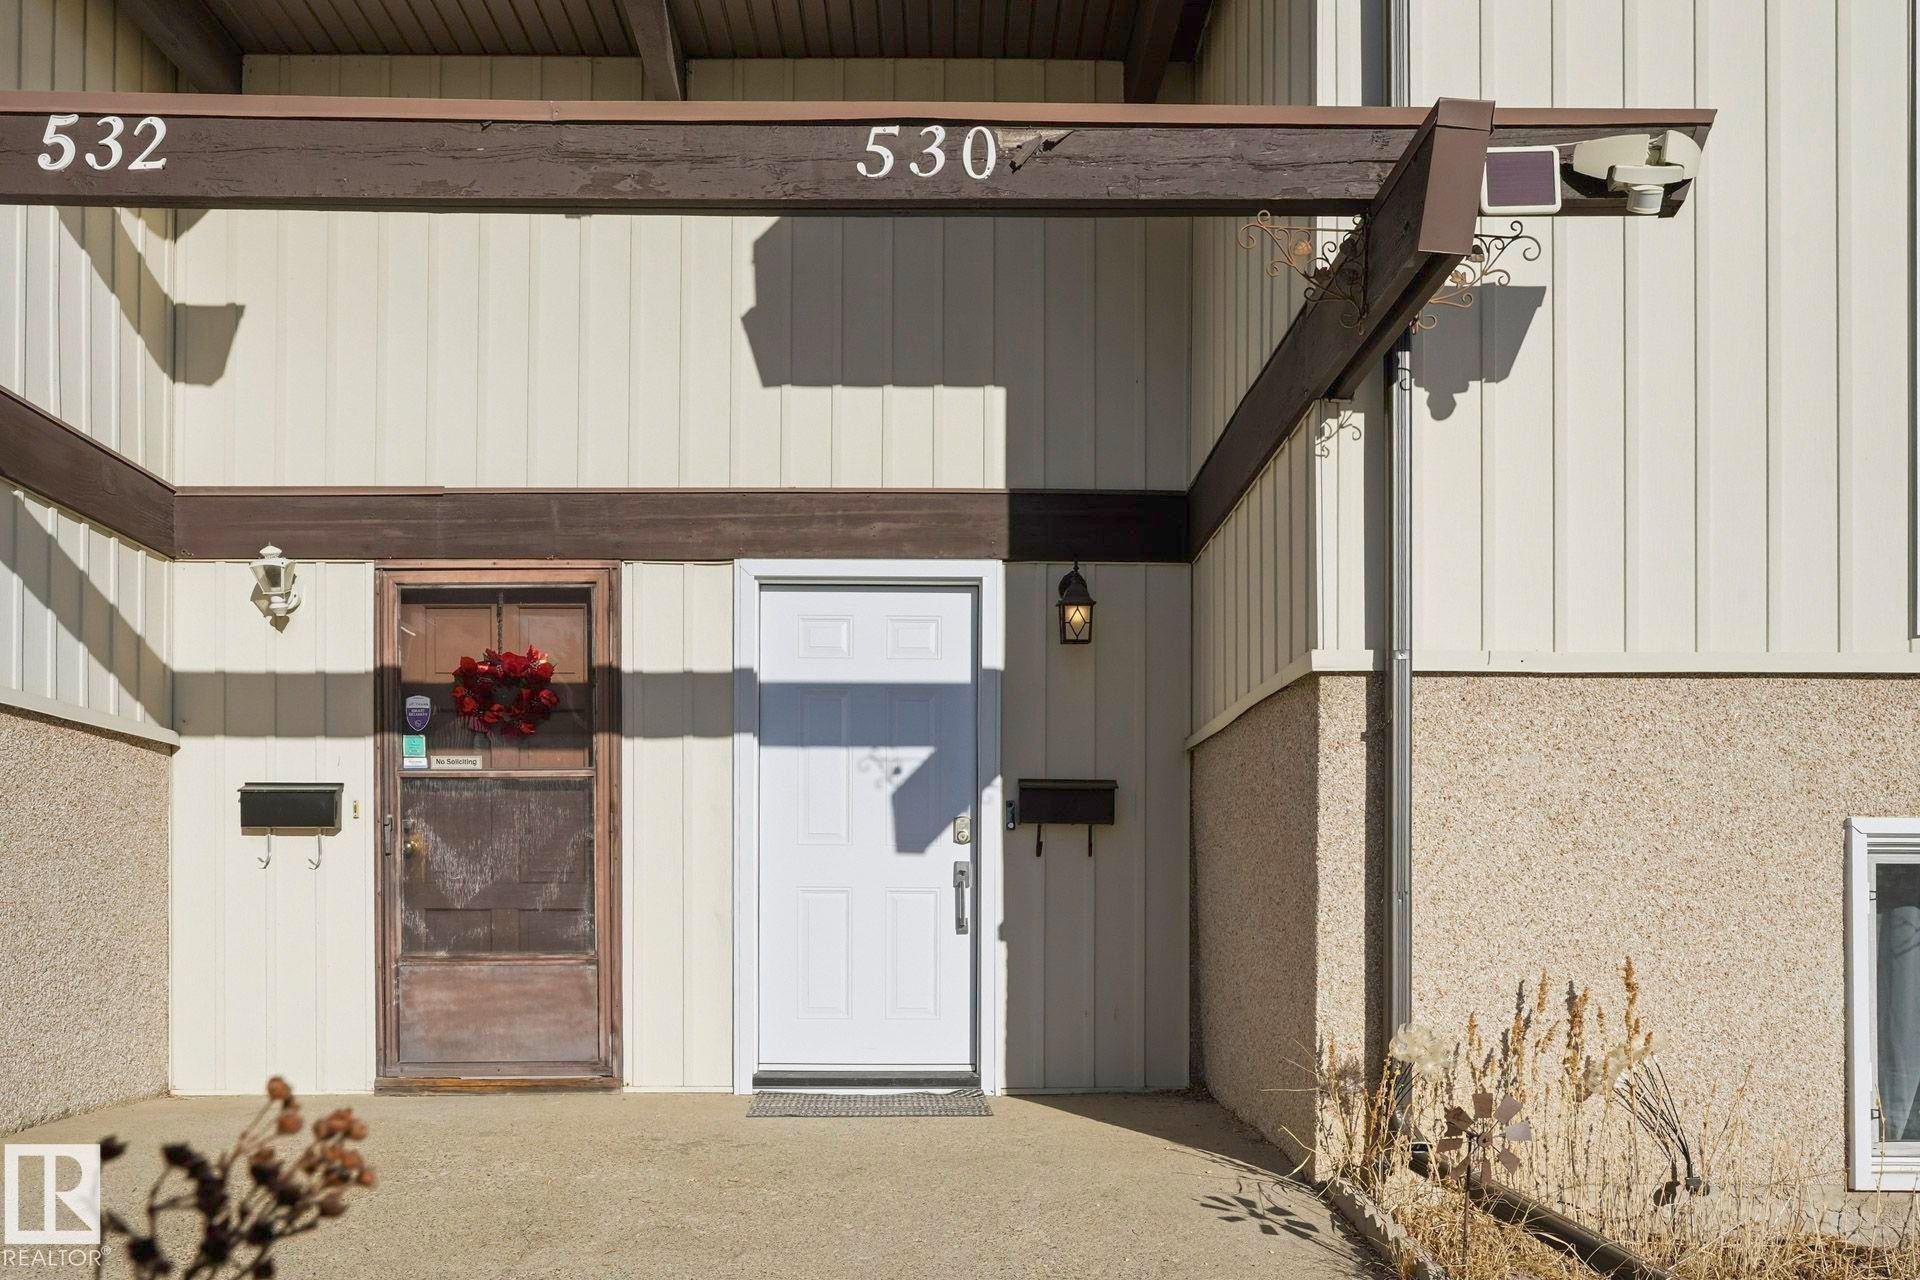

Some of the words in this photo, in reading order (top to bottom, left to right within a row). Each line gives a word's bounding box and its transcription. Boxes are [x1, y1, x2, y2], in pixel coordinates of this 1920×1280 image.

[37, 113, 168, 171] 532
[856, 125, 997, 180] 530
[446, 758, 477, 766] Soliciting
